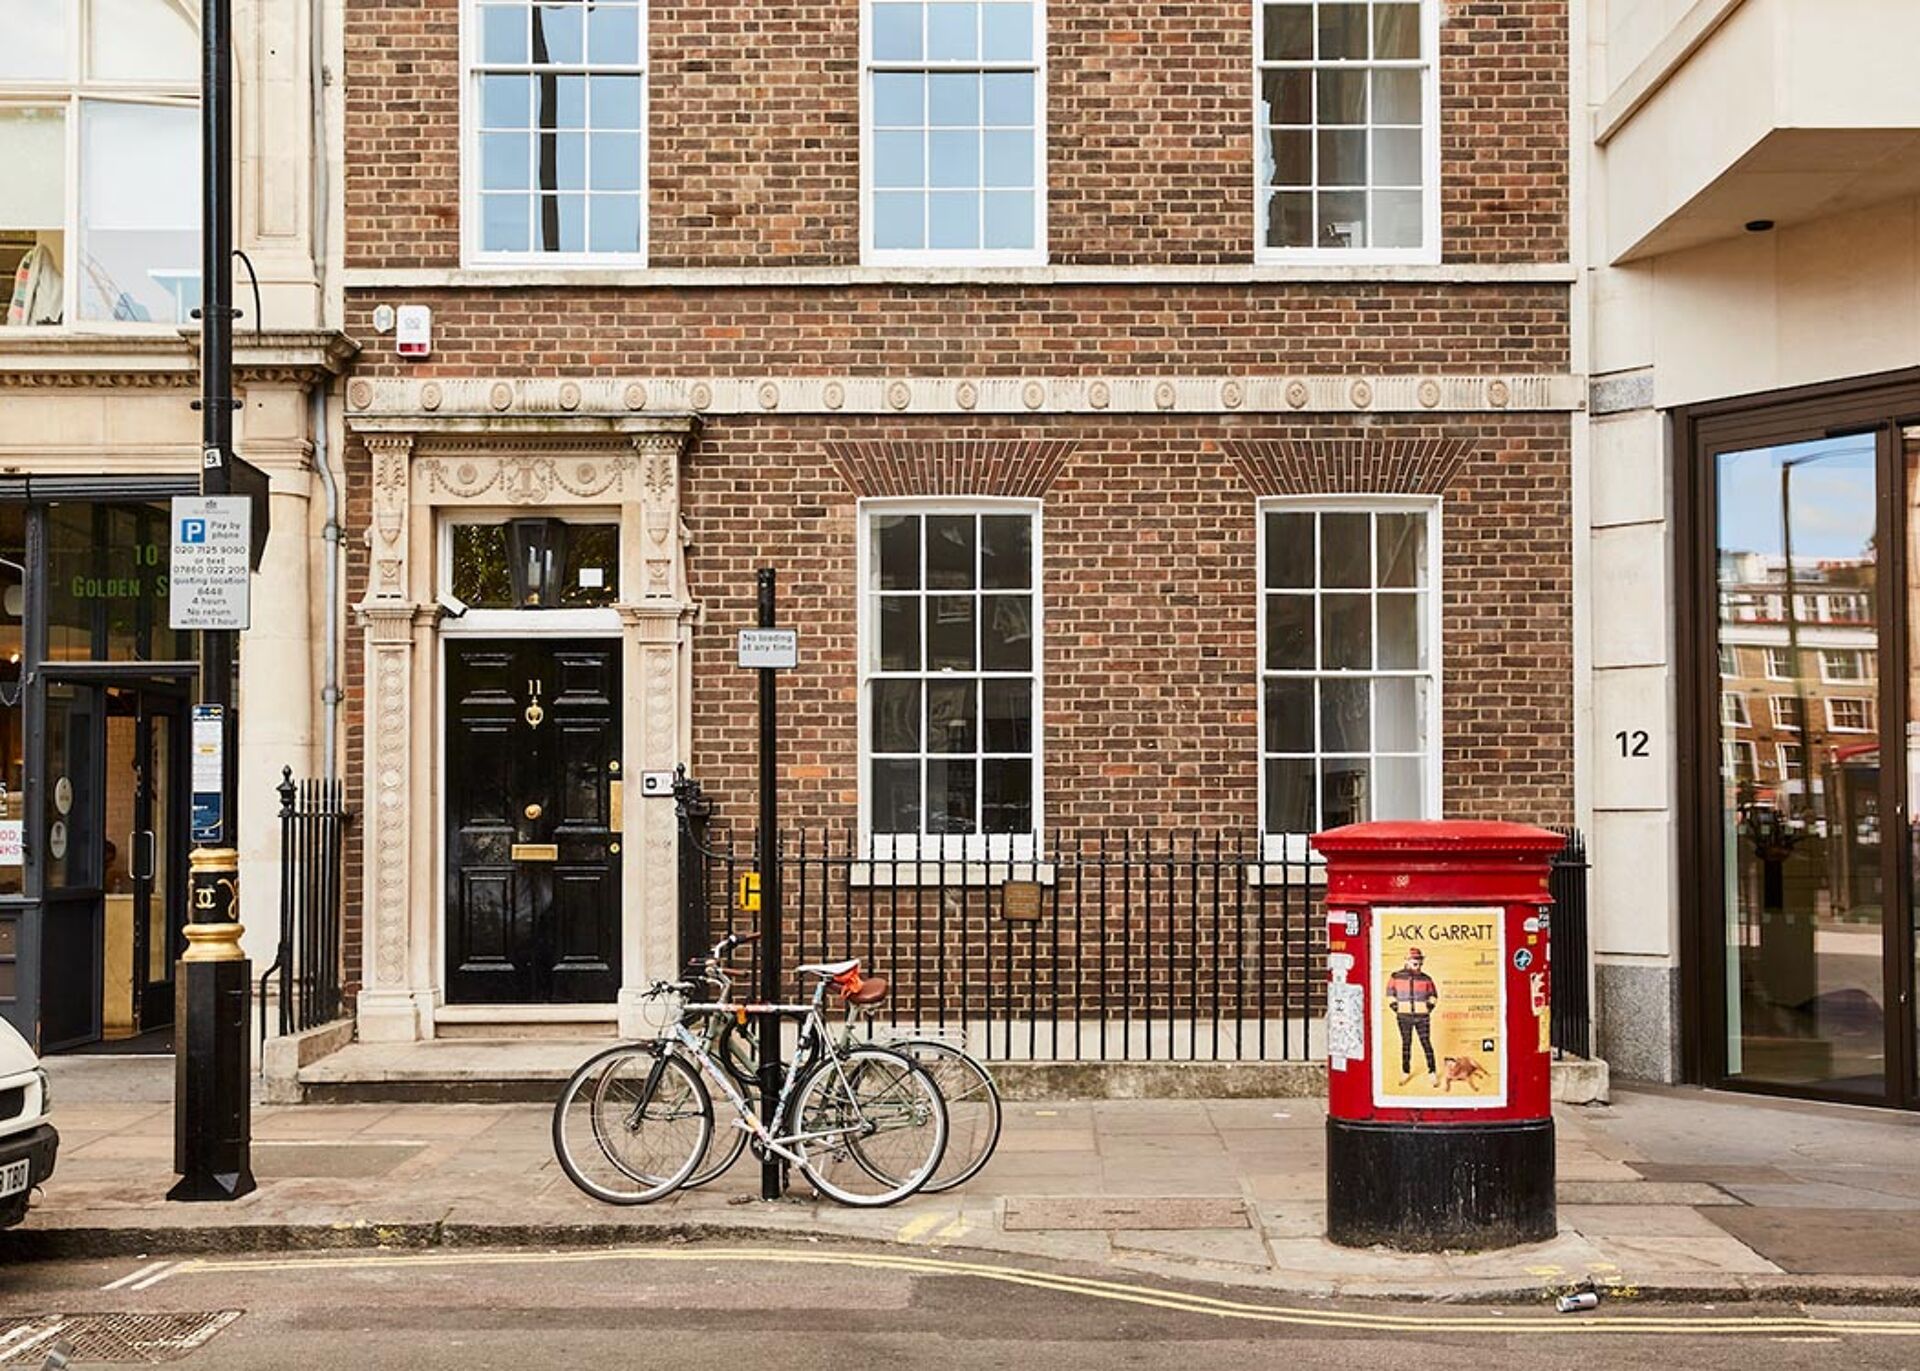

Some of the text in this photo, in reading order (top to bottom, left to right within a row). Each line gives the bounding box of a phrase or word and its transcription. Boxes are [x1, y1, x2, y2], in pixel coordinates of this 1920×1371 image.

[210, 521, 241, 531] Pay by
[187, 521, 203, 542] P
[211, 532, 240, 541] phone
[133, 543, 159, 566] 10
[174, 546, 194, 554] 020
[197, 546, 218, 554] 7125
[206, 557, 226, 565] text
[206, 566, 226, 574] 022
[72, 575, 141, 598] GOLDEN
[173, 577, 247, 586] quoting location
[201, 597, 227, 605] hours
[743, 633, 793, 643] No loading
[742, 643, 752, 651] at
[773, 643, 793, 651] time
[527, 679, 542, 695] 11
[1615, 730, 1649, 757] 12
[1387, 924, 1493, 940] JACK GARRATT
